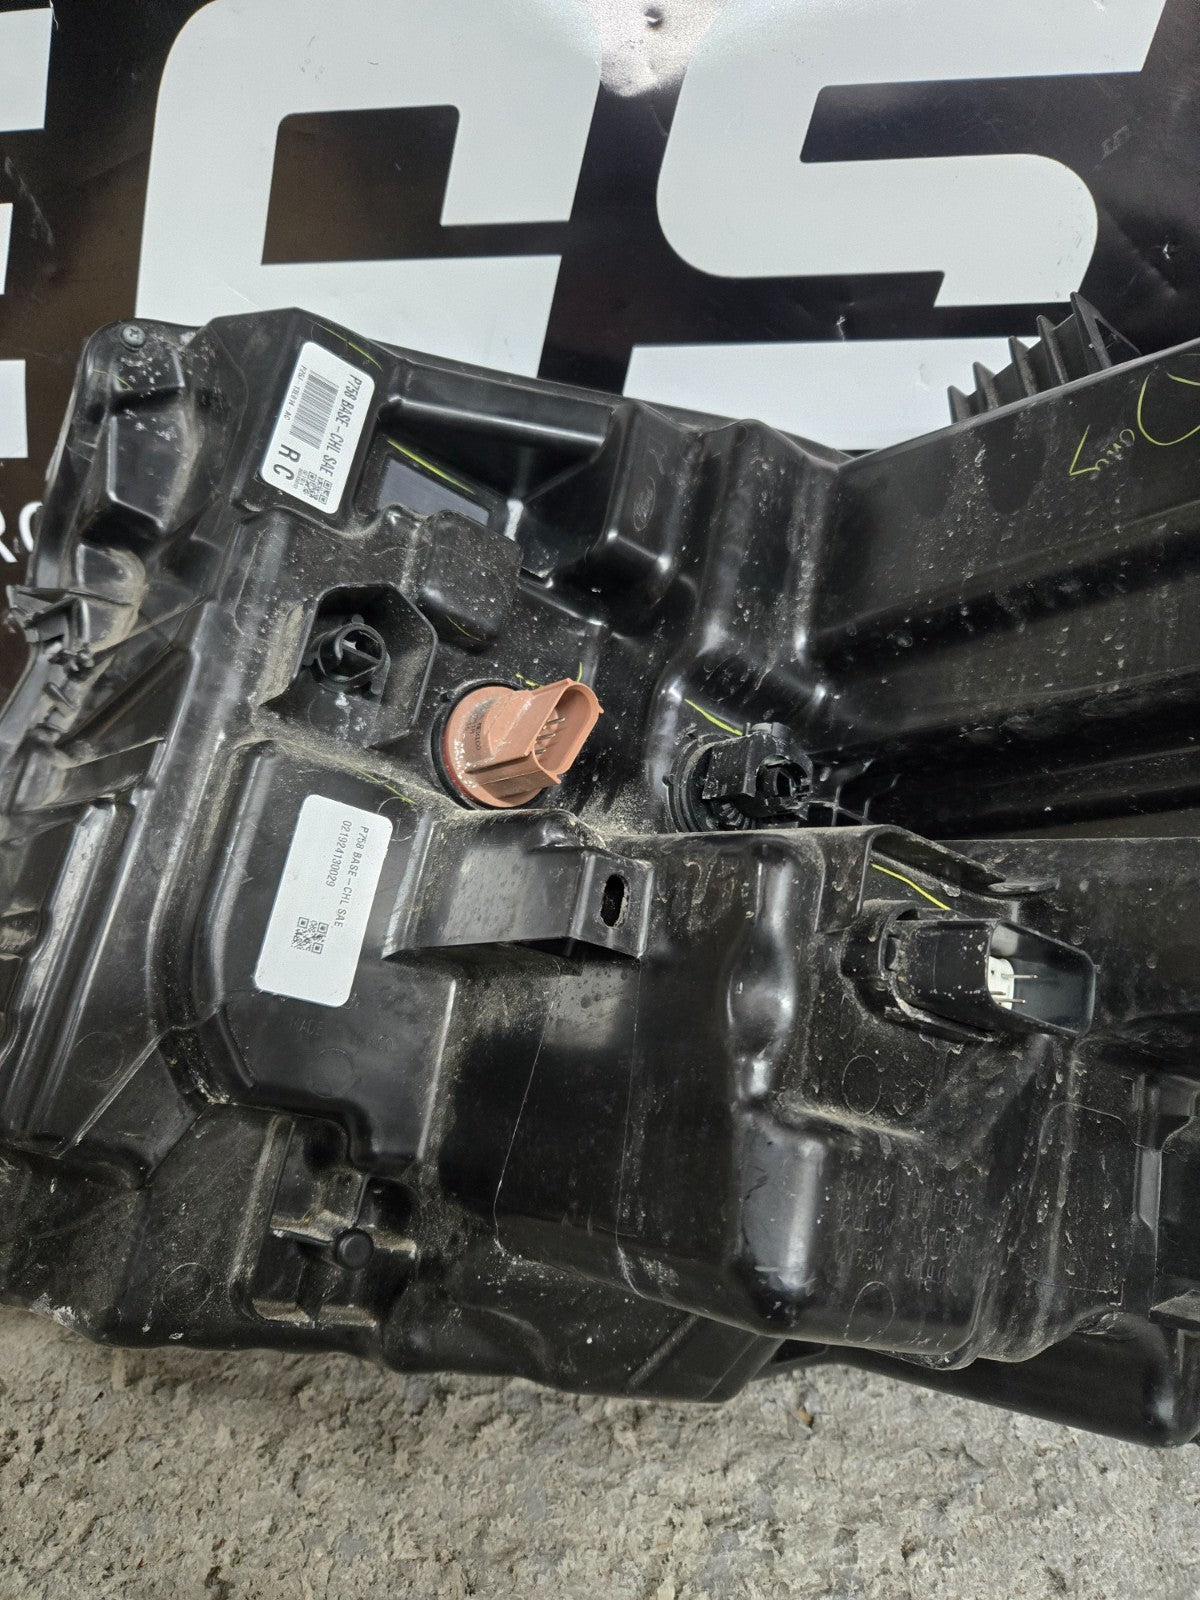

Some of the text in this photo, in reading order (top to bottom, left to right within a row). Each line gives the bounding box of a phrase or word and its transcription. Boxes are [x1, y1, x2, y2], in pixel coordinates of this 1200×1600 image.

[344, 374, 363, 401] P758
[319, 454, 338, 477] SAE
[357, 825, 370, 850] P758
[326, 820, 353, 888] 021924130029
[333, 907, 347, 928] SAE
